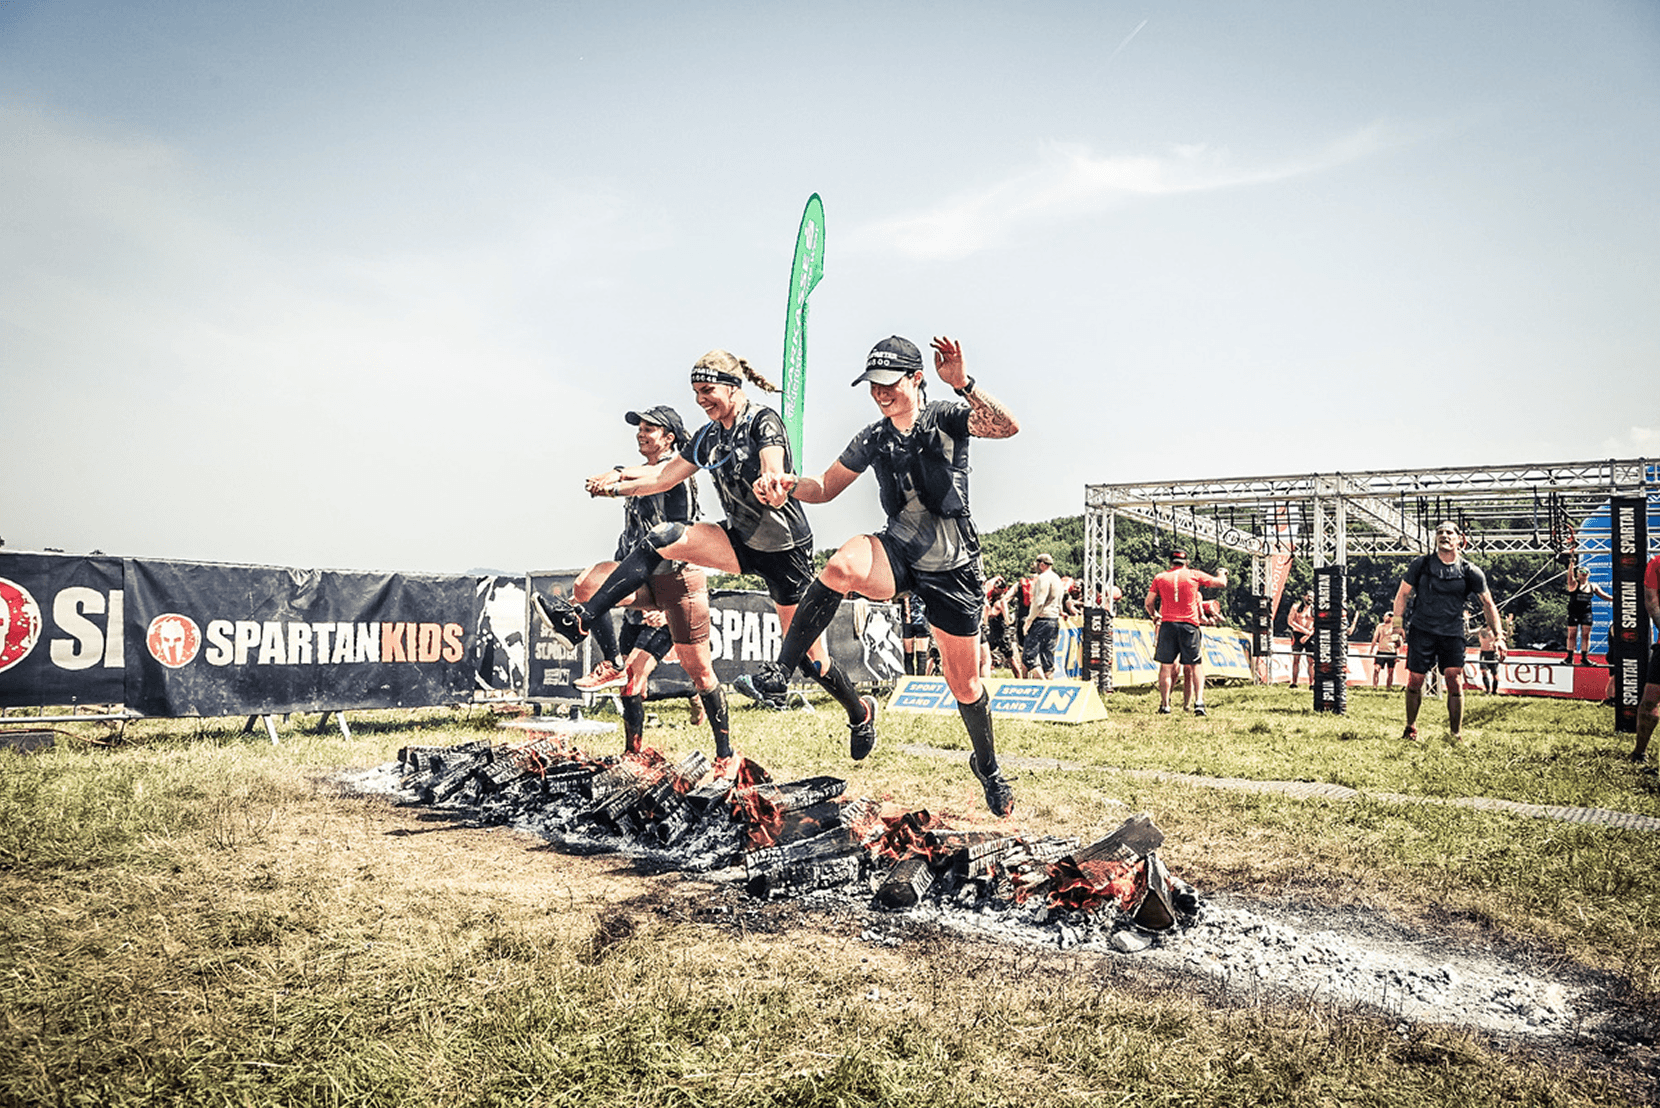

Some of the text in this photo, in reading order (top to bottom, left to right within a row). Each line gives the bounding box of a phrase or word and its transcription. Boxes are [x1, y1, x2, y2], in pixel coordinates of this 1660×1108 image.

[1619, 507, 1636, 554] SPARTAN
[1318, 574, 1331, 610] SPARTAN
[1621, 581, 1638, 629] SPARTAN
[1319, 628, 1332, 663] SPARTAN
[908, 683, 942, 693] SPORT
[1001, 686, 1039, 697] SPORT
[1623, 659, 1639, 706] SPARTAN
[901, 697, 931, 706] LAND
[995, 701, 1028, 711] LAND
